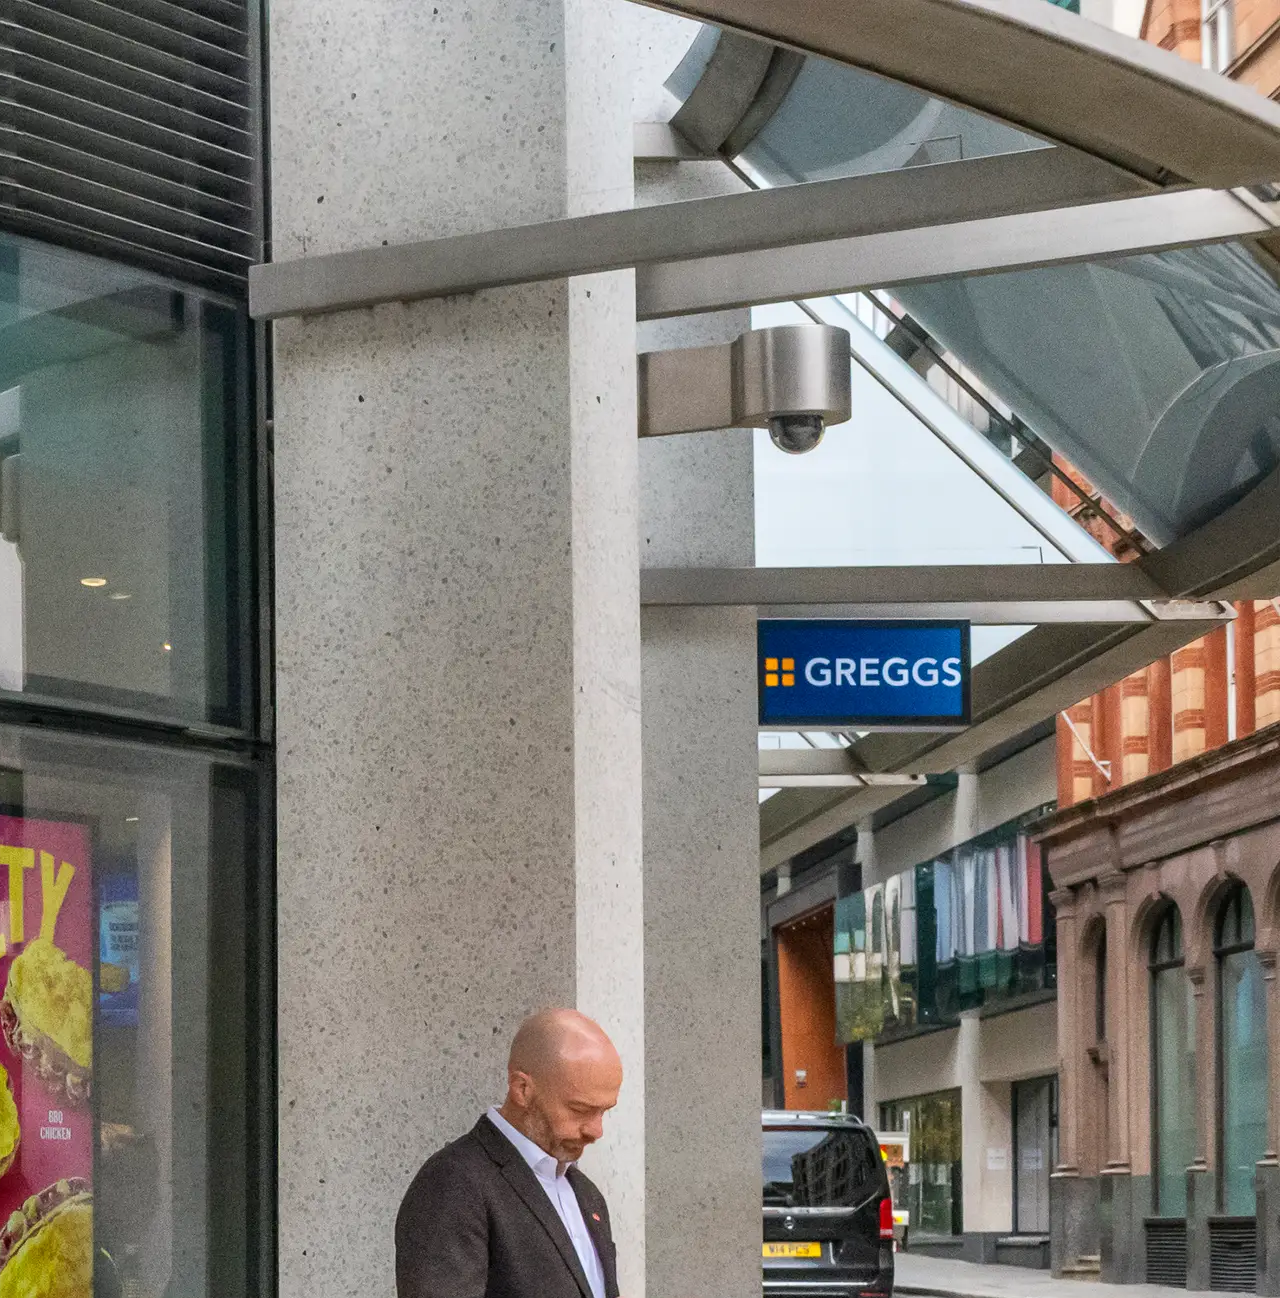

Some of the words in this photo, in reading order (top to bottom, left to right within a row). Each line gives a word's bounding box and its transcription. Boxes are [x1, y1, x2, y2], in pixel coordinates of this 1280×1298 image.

[803, 656, 962, 687] GREGGS
[48, 1110, 63, 1123] BBQ
[40, 1127, 71, 1139] CHICKEN
